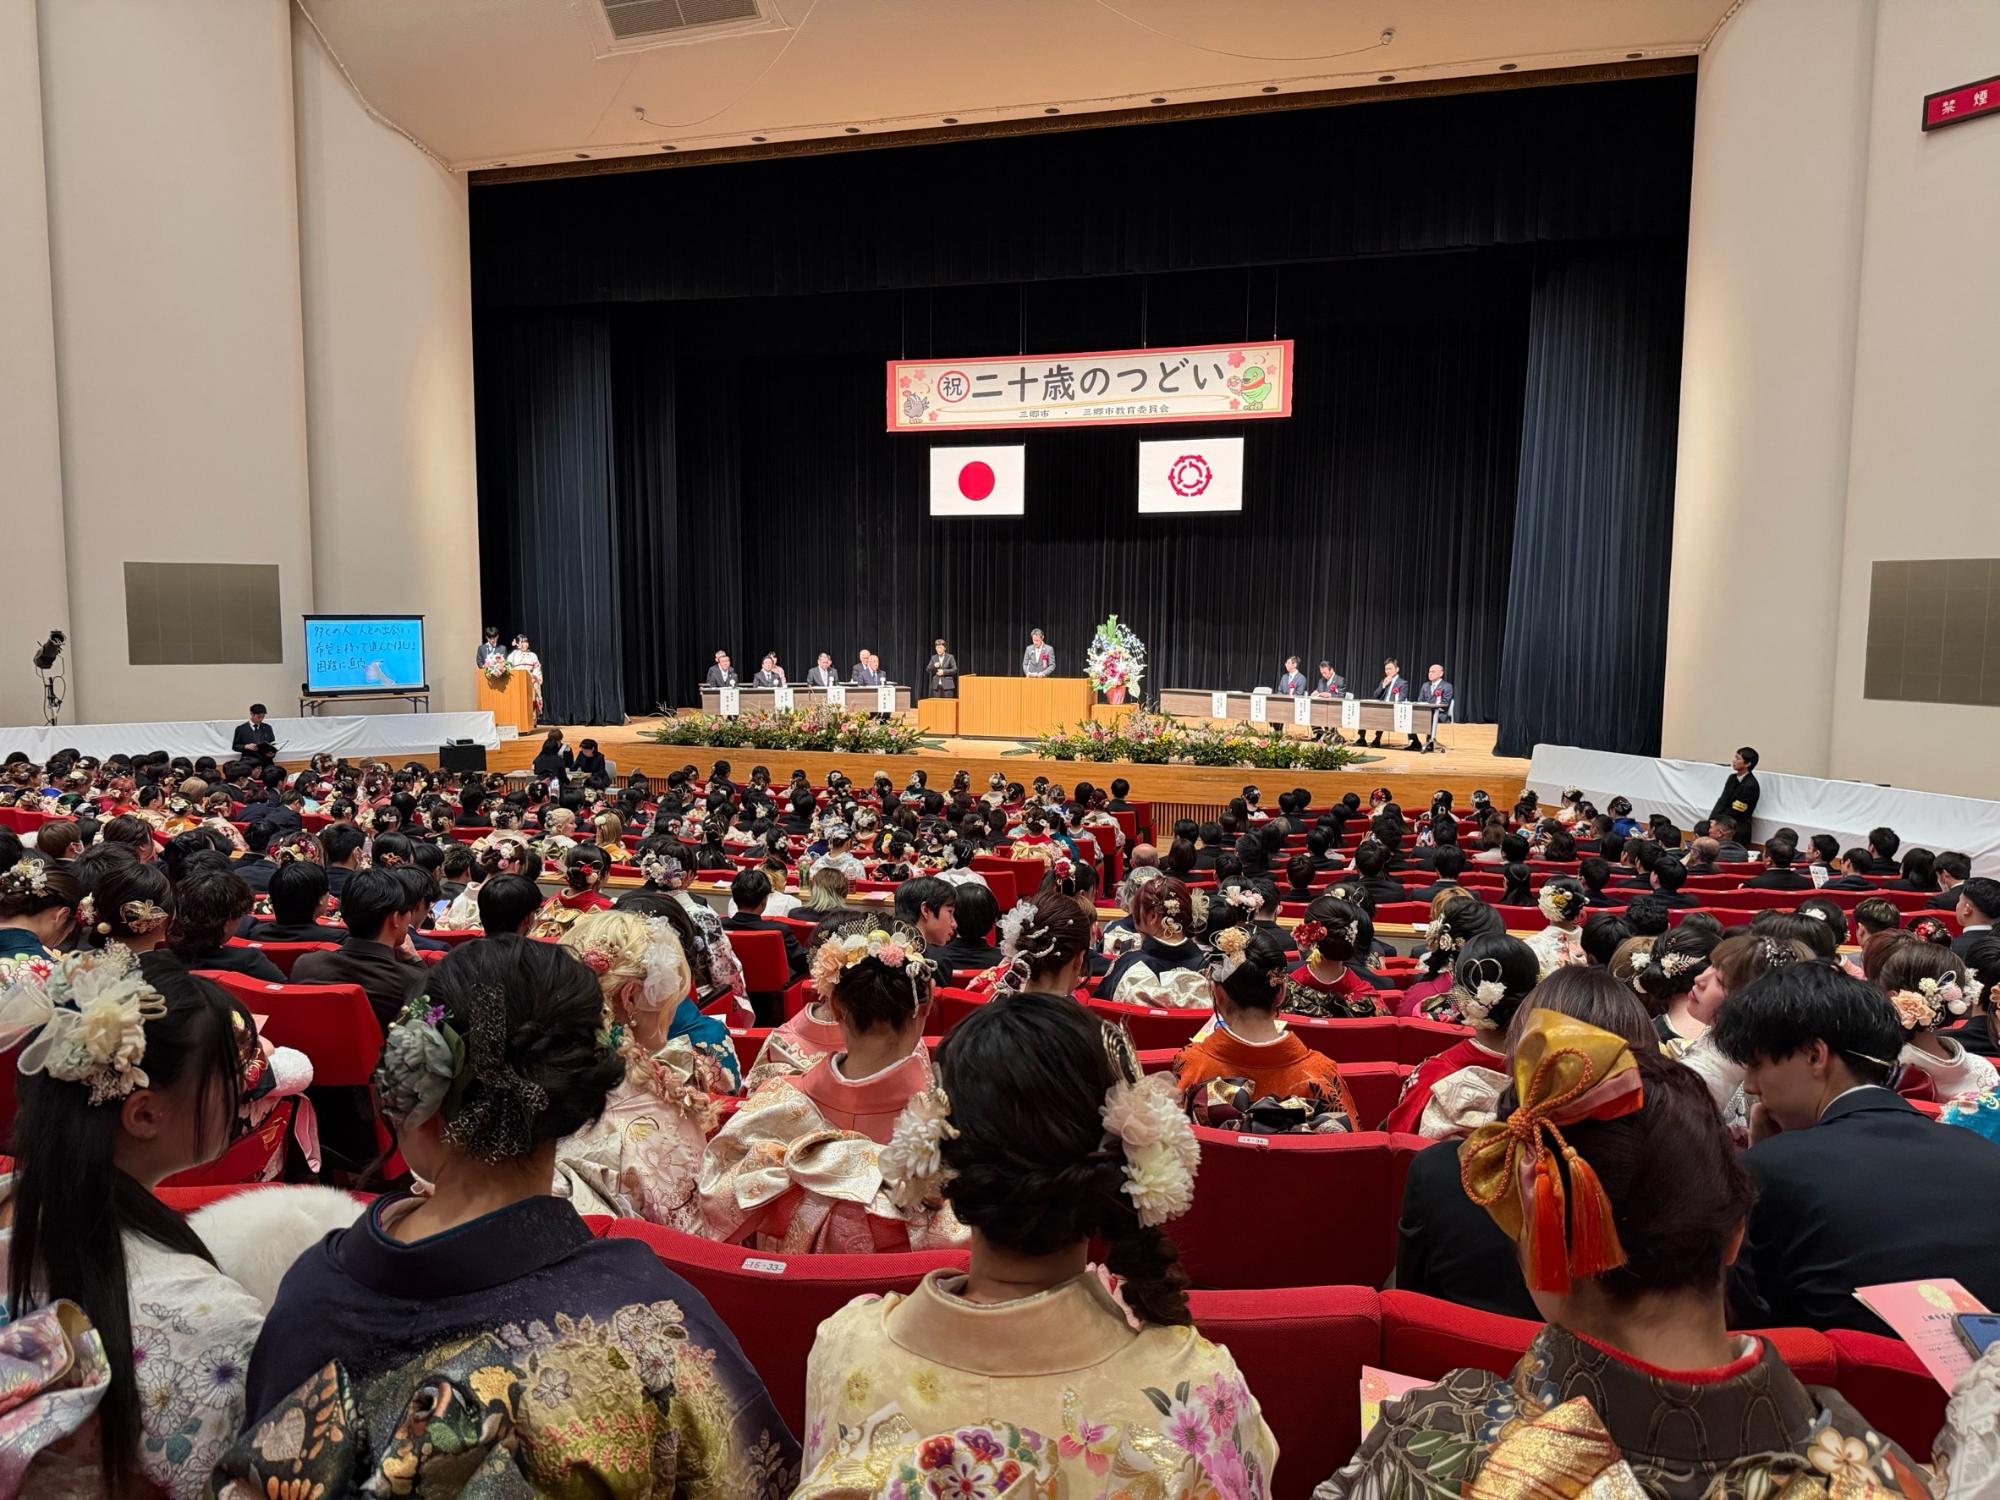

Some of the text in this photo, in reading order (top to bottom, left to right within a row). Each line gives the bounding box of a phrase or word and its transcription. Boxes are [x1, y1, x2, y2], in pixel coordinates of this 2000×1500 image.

[940, 357, 1224, 402] 祝 二十歳のつどい
[1082, 404, 1169, 416] 三郷市教育委員会
